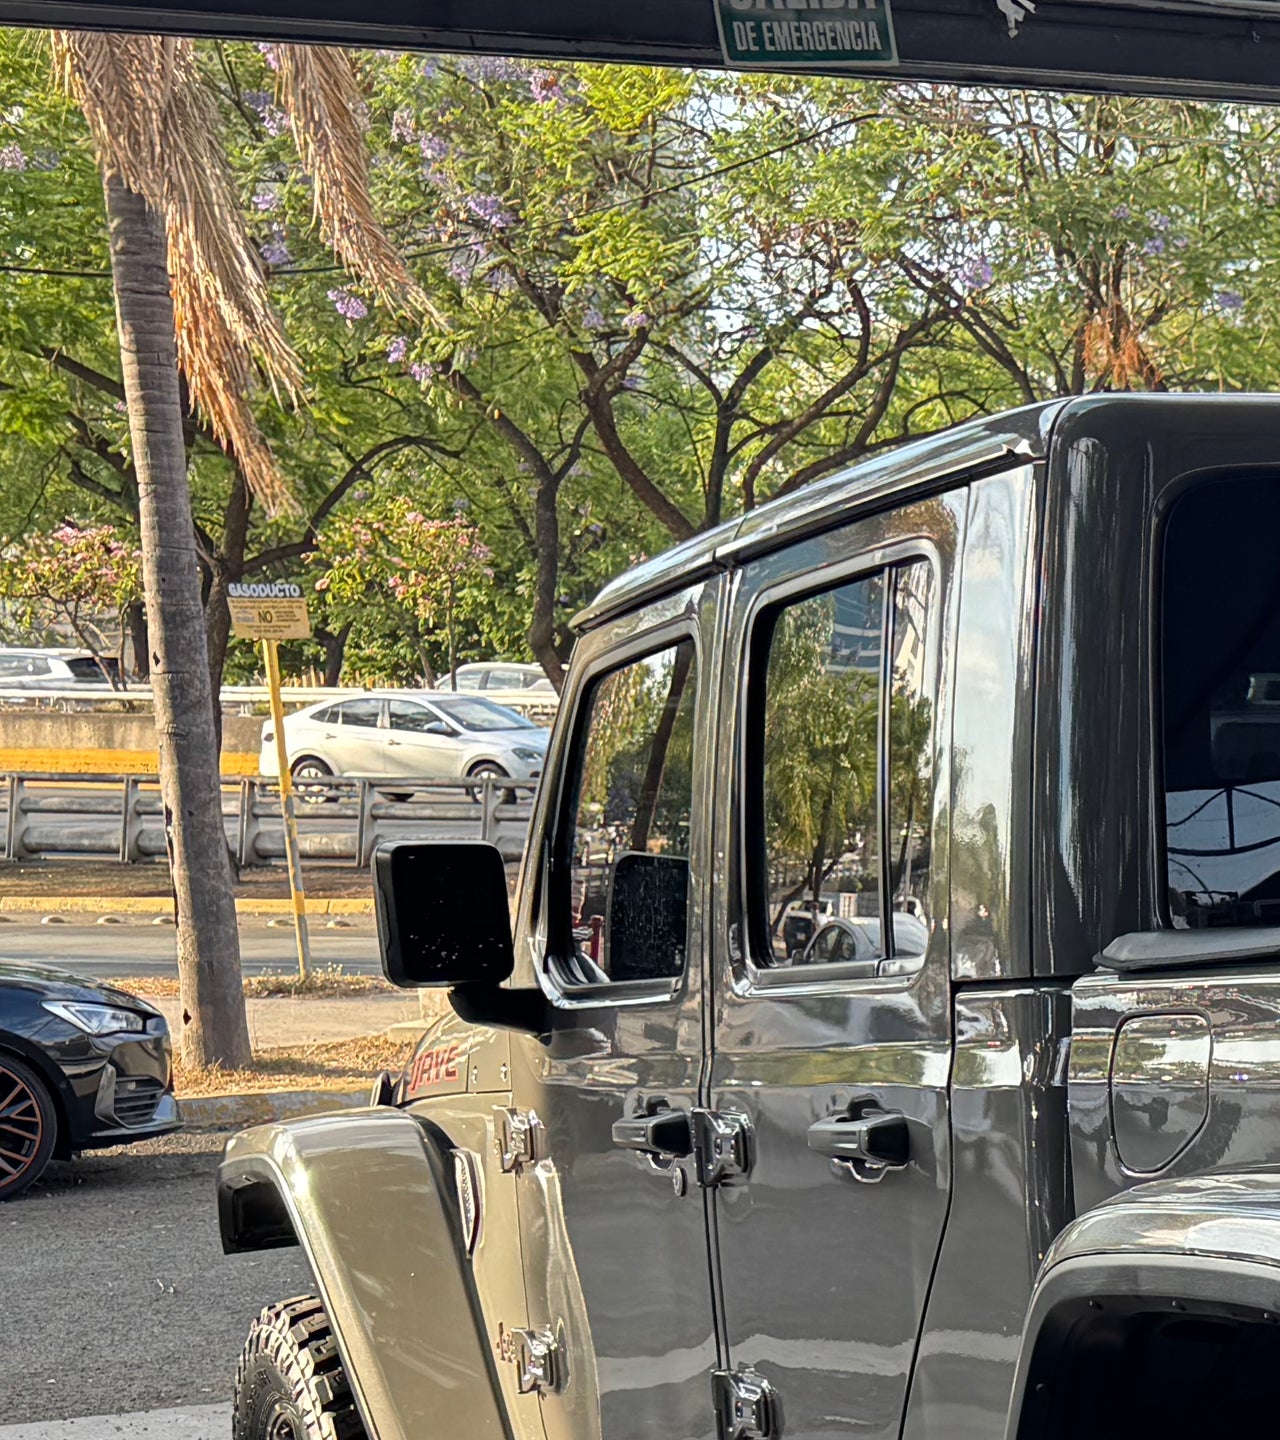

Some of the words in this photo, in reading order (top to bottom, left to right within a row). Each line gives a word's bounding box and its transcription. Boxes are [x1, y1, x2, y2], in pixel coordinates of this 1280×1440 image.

[732, 21, 760, 51] DE
[762, 20, 882, 51] EMERGENCIA
[228, 583, 300, 597] GASODUCTO
[258, 610, 273, 624] NO
